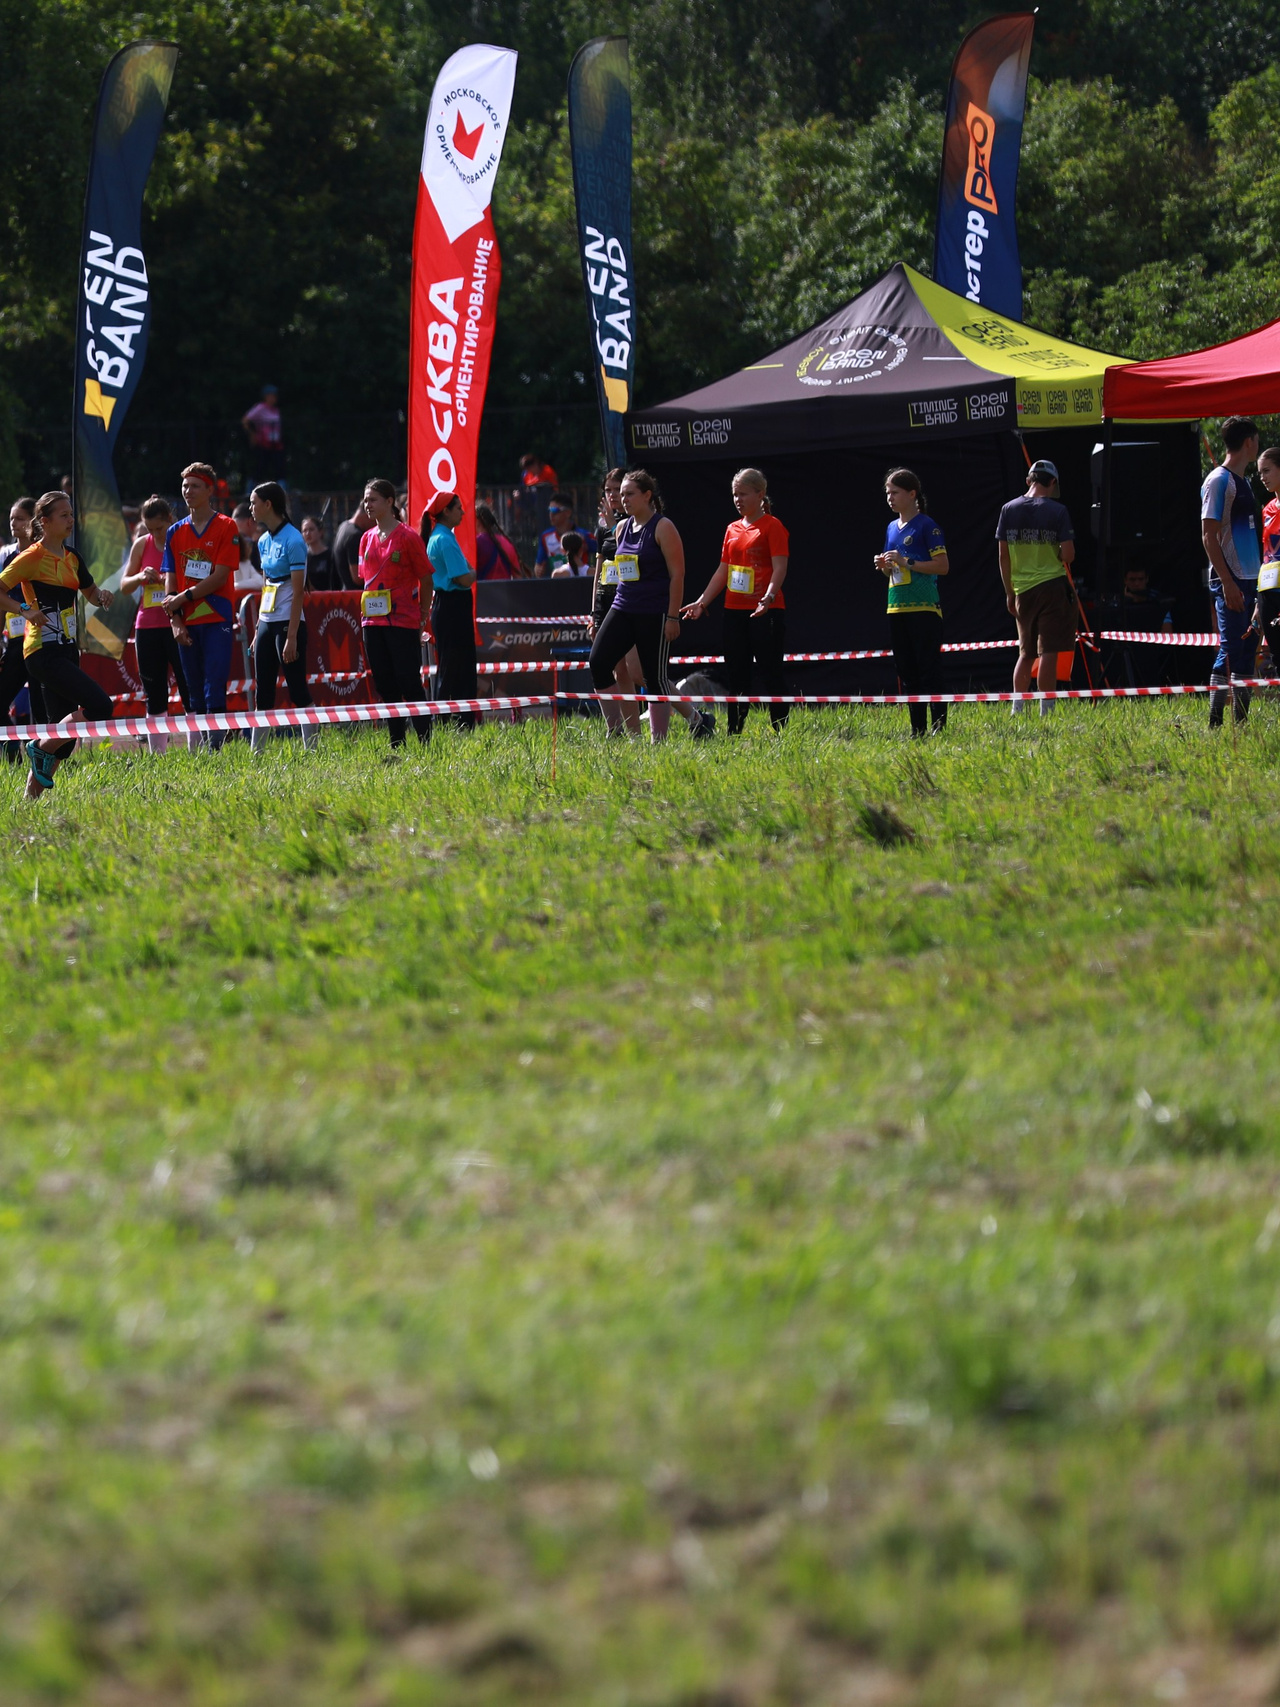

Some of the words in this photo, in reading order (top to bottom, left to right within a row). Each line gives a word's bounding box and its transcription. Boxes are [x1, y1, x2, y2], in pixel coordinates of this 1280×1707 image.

[443, 88, 501, 131] МОСКОВСКОЕ
[600, 237, 632, 370] BAND
[95, 246, 149, 389] BAND
[454, 237, 494, 428] ОРИЕНТИРОВАНИЕ
[821, 358, 874, 371] BAND
[426, 276, 464, 496] ОСКВА
[911, 398, 959, 414] TIMING
[971, 405, 1006, 420] BAND
[925, 411, 958, 426] BAND
[635, 422, 681, 436] TIMING
[647, 435, 681, 449] BAND
[693, 431, 729, 446] BAND
[318, 608, 361, 636] МОСКОВСКОЕ
